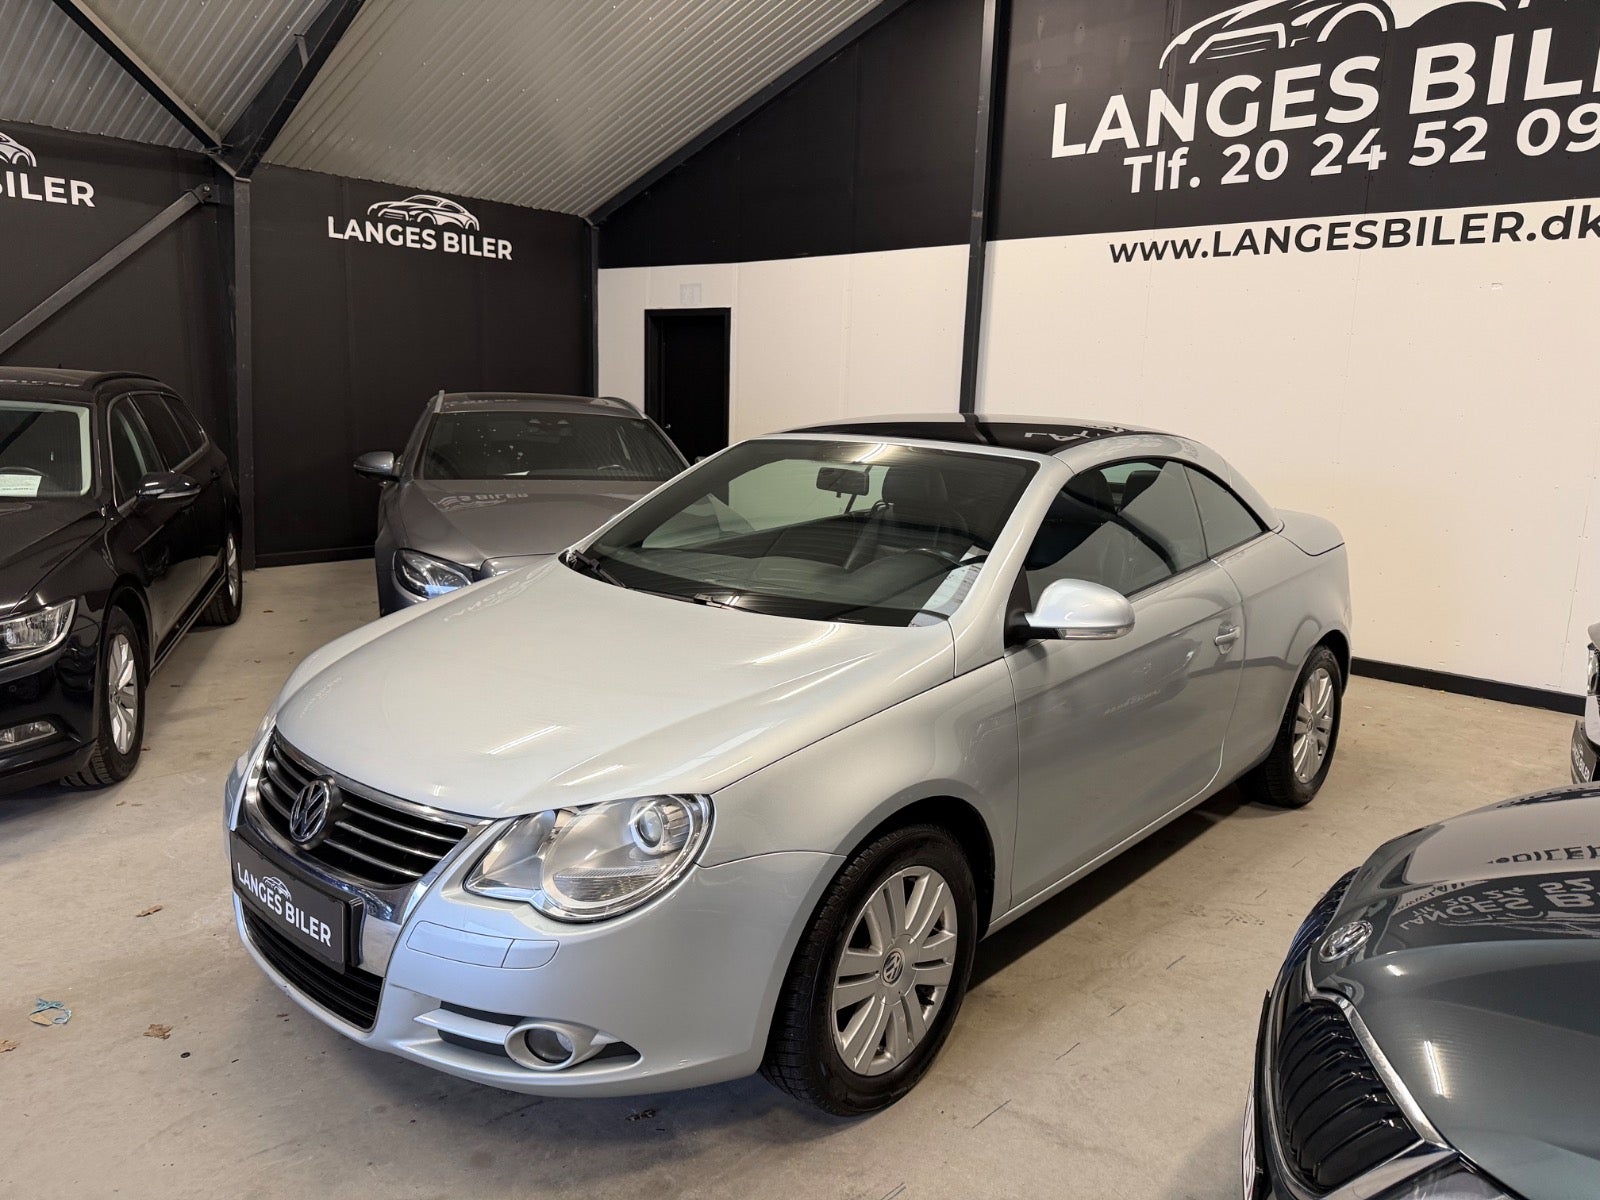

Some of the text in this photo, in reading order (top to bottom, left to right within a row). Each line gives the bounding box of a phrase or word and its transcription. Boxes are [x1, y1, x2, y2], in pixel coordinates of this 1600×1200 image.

[1051, 27, 1600, 158] LANGES BIL
[1123, 103, 1600, 194] Tlf. 20 24 52 09
[0, 169, 96, 208] ILER
[327, 215, 513, 261] LANGES BILER
[1108, 205, 1600, 264] www.LANGESBILER.dk
[237, 861, 332, 948] LANGES BILER
